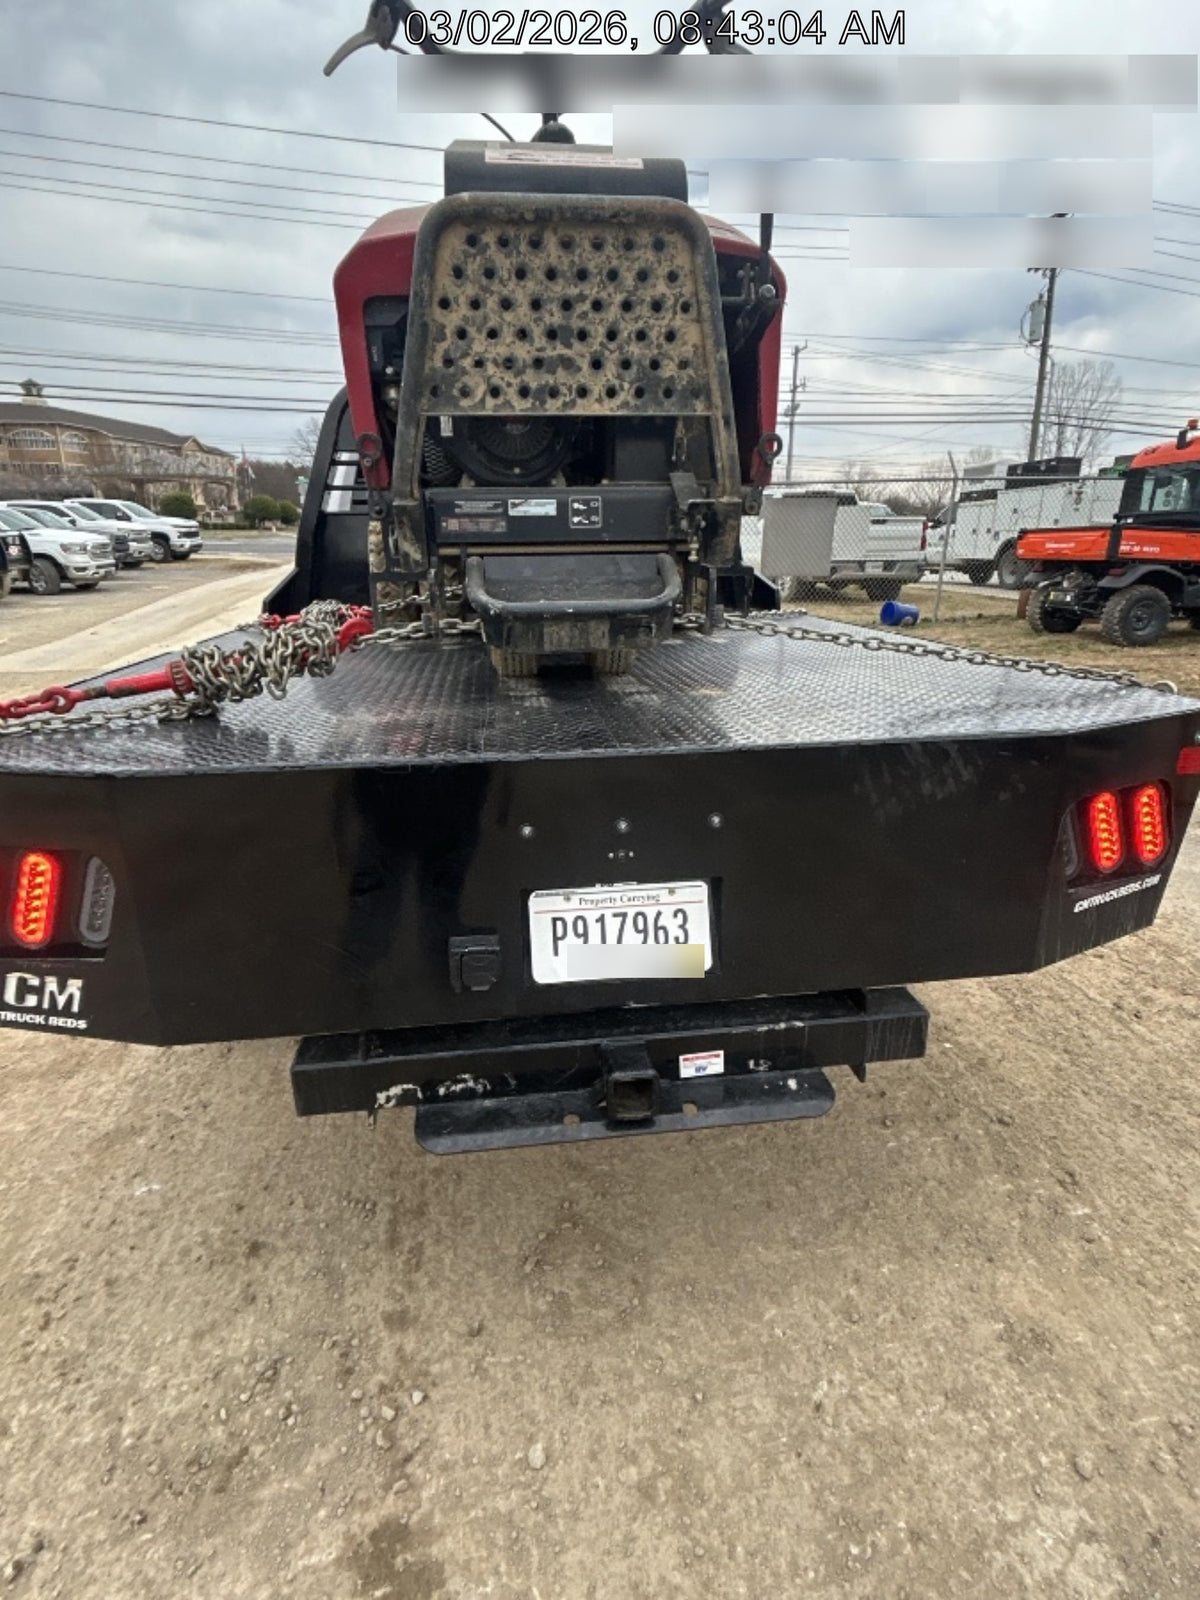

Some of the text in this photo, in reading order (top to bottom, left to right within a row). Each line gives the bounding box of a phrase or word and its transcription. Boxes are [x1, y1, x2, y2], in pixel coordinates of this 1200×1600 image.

[578, 893, 661, 907] Property Carrying
[551, 908, 690, 957] P917963
[3, 971, 83, 1013] CM
[0, 1010, 88, 1030] TRUCK BEDS
